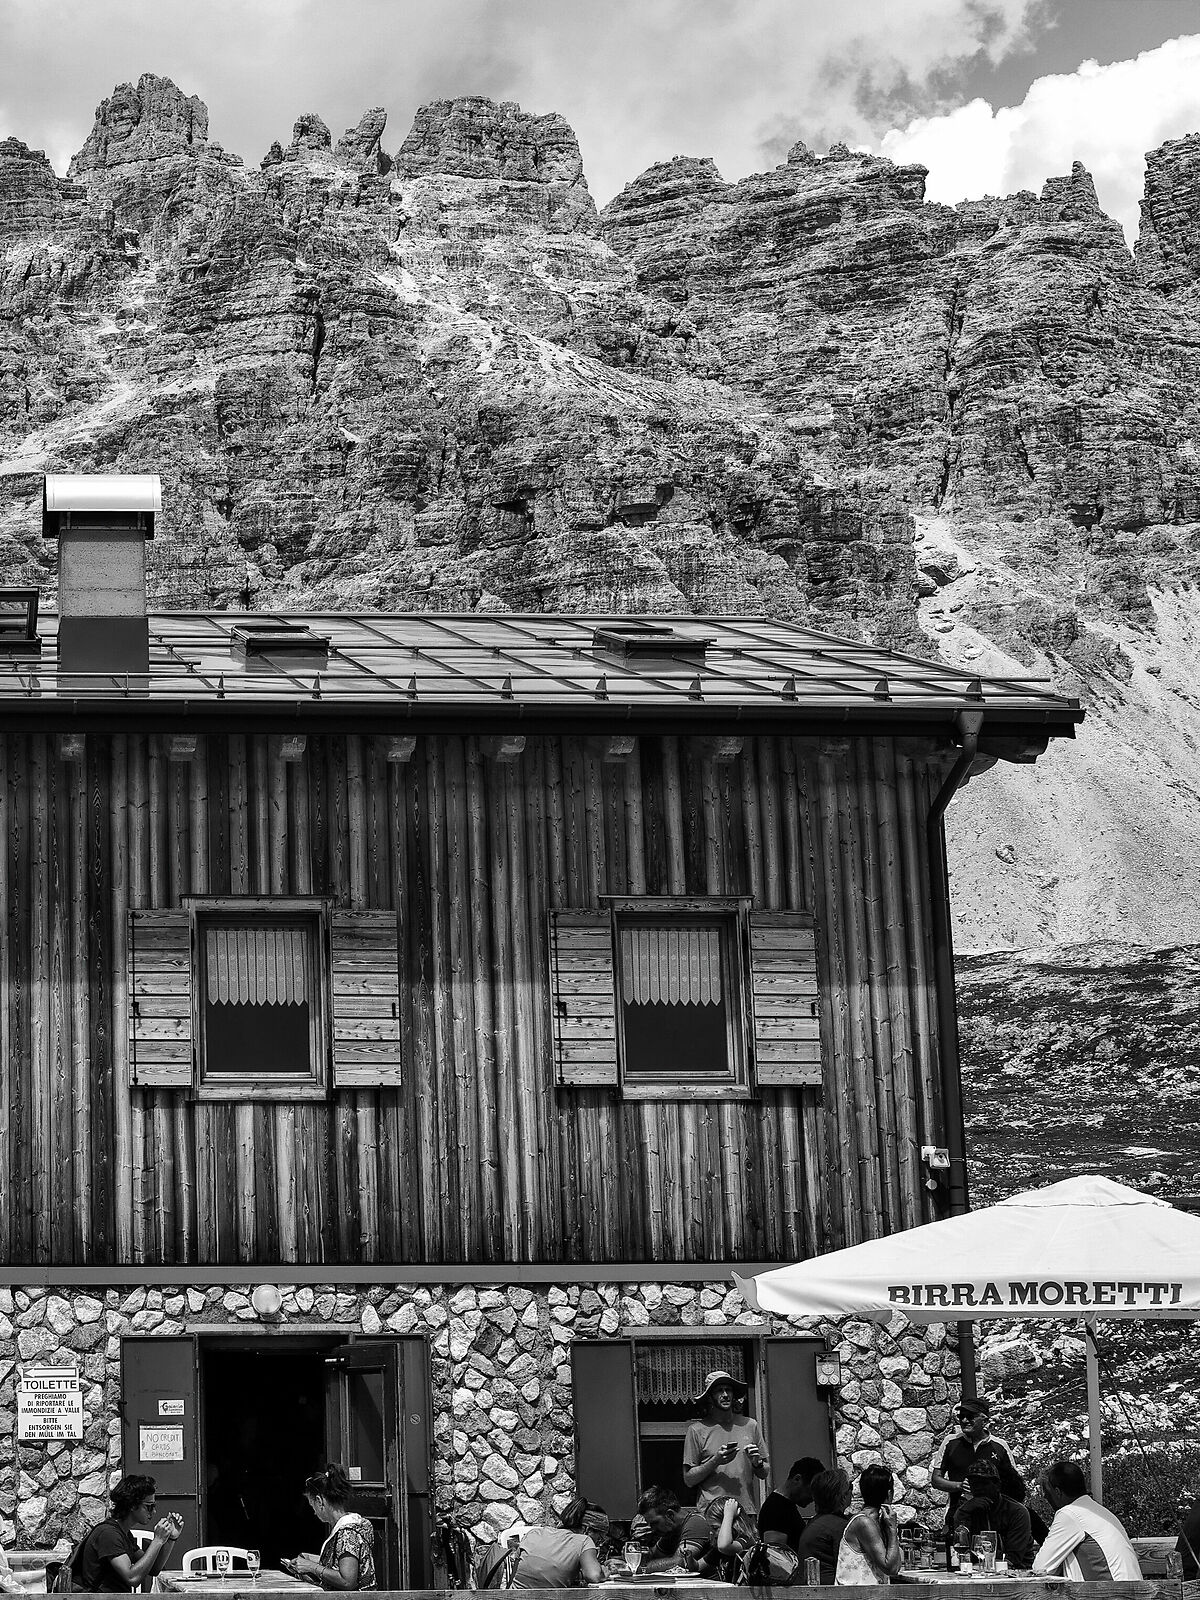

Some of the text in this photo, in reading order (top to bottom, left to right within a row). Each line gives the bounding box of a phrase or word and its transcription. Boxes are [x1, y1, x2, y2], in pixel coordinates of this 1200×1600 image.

[888, 1281, 1183, 1306] BIRRA MORETTI
[23, 1380, 77, 1390] TOILETTE
[146, 1433, 159, 1442] NO
